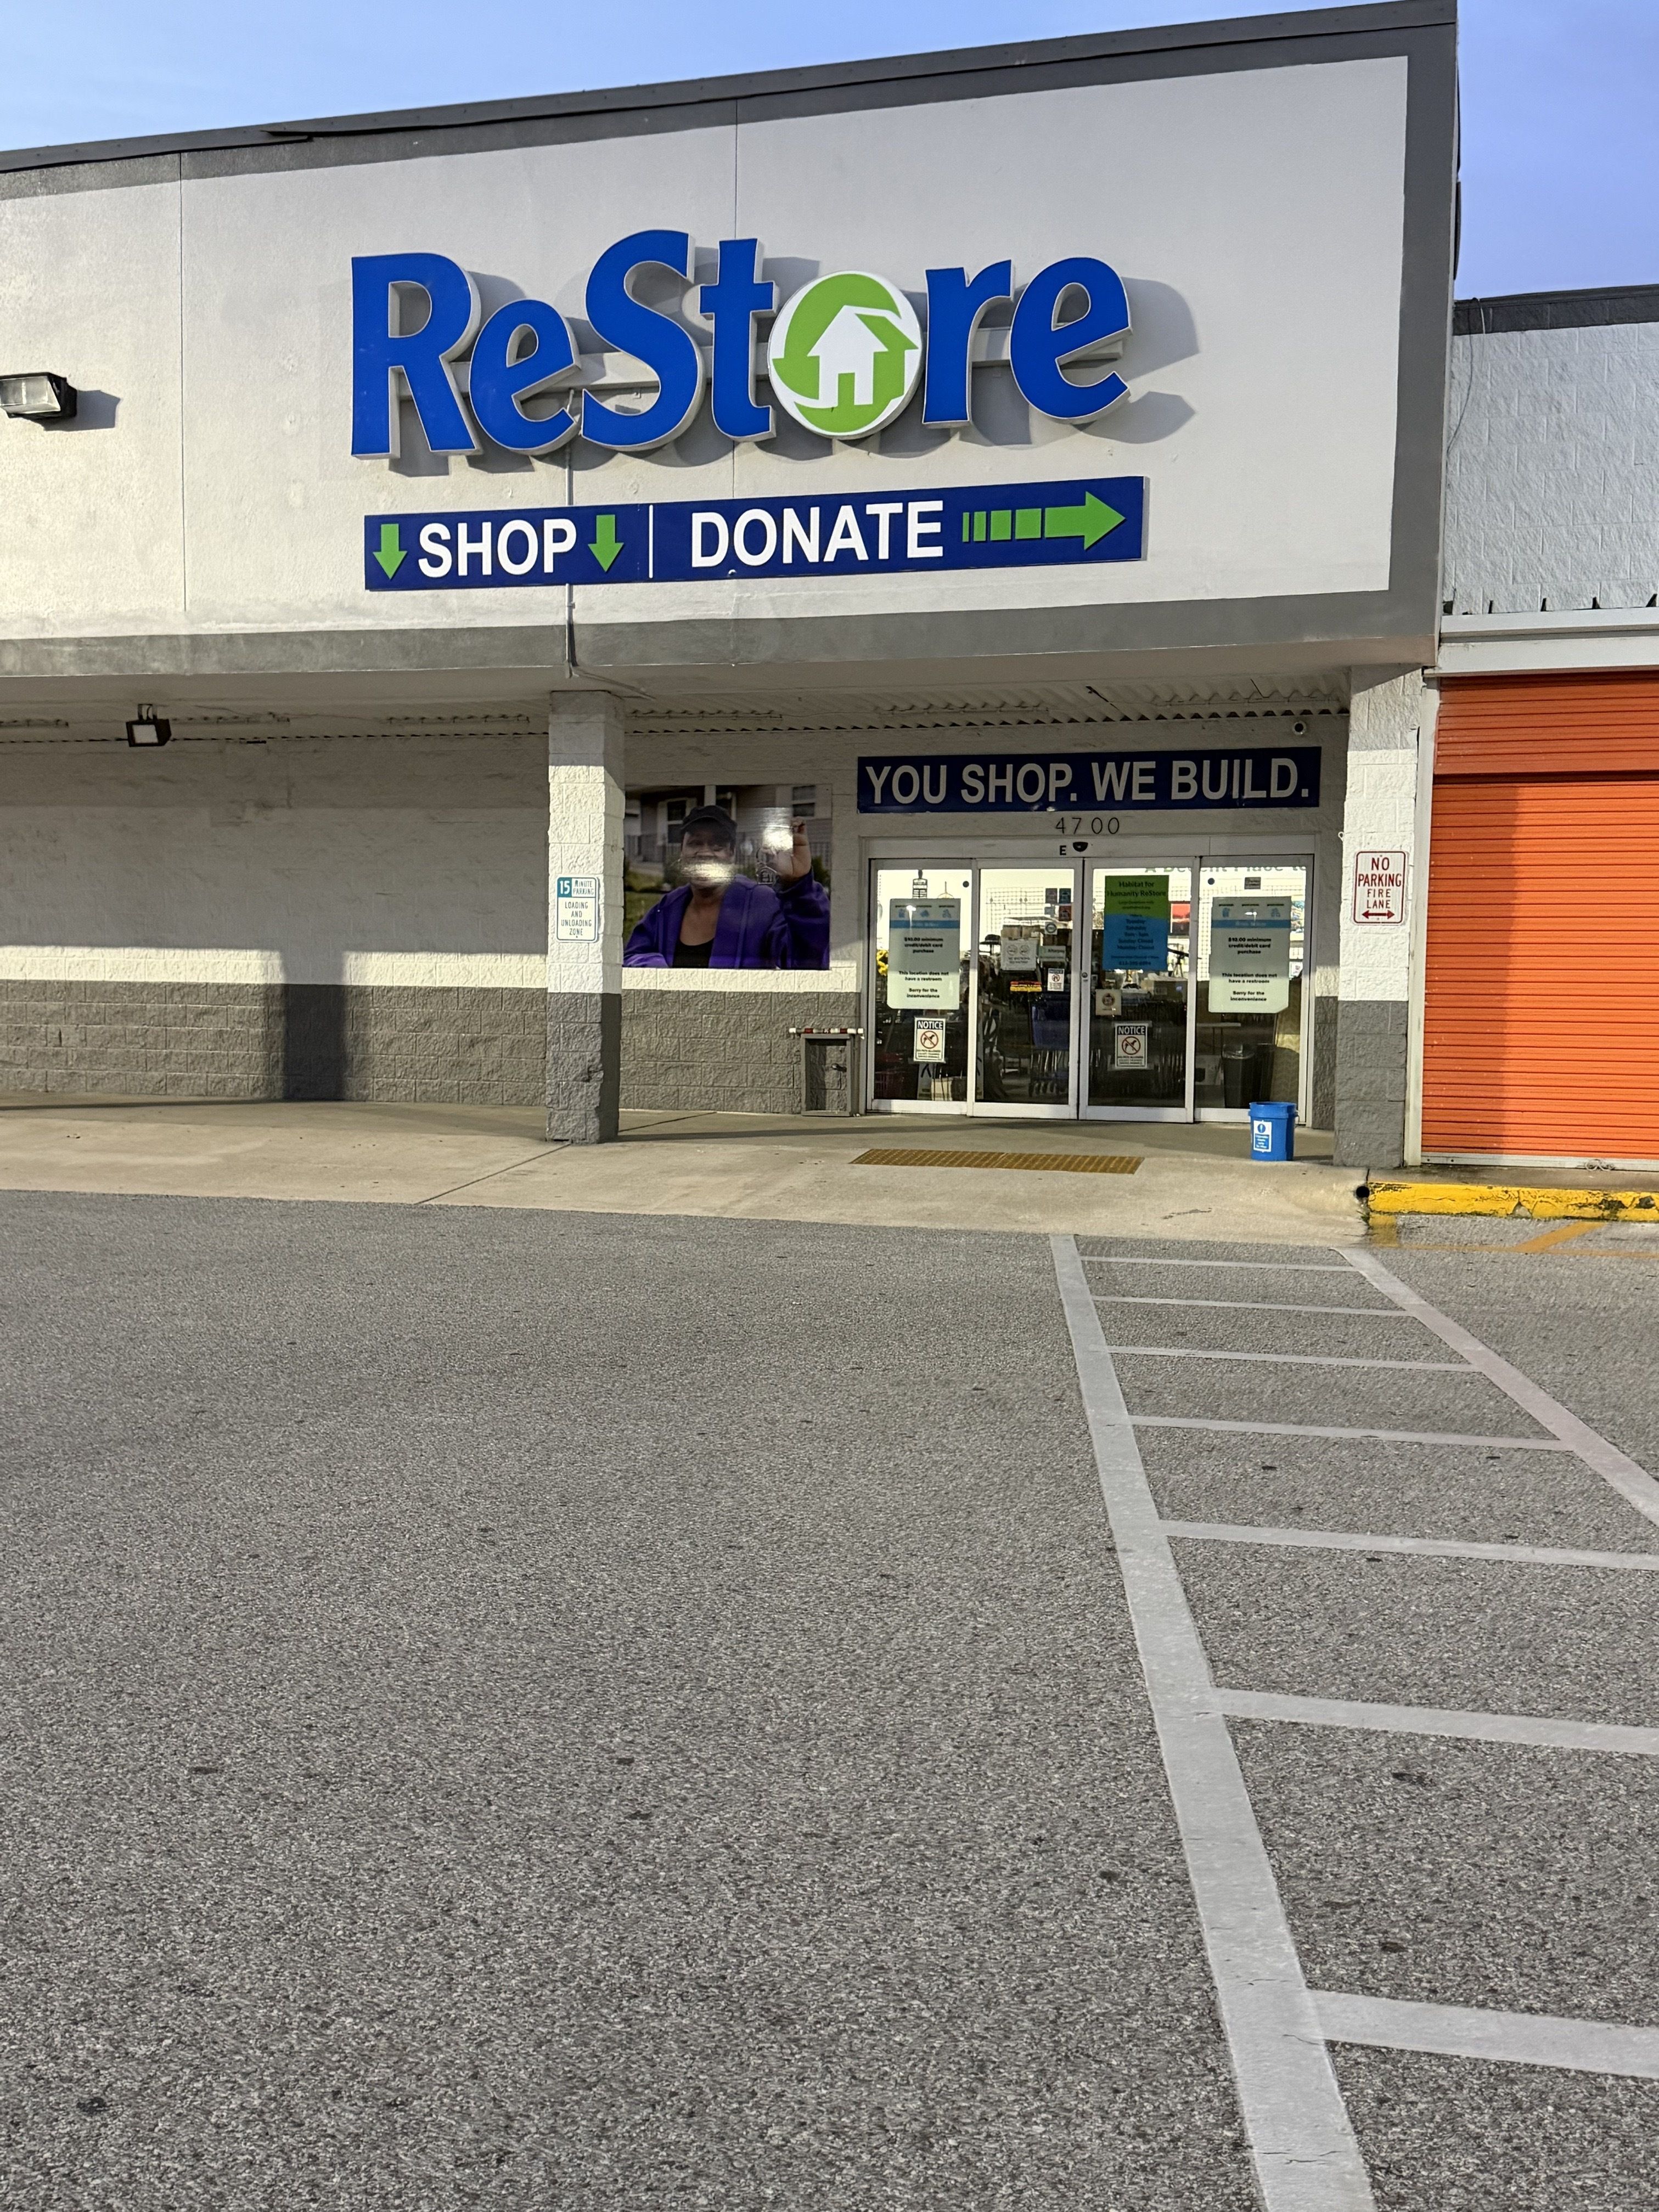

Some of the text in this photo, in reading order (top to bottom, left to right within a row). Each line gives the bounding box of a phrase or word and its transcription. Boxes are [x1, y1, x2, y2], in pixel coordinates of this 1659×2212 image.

[418, 500, 943, 578] SHOP DONATE
[865, 758, 1309, 804] YOU SHOP. WE BUILD.
[1055, 817, 1120, 834] 4700
[1371, 857, 1390, 871] NO
[560, 880, 570, 894] 15
[1358, 873, 1402, 887] PARKING
[1367, 888, 1391, 898] FIRE
[1366, 899, 1391, 909] LANE
[918, 1021, 943, 1029] NOTICE
[1118, 1026, 1145, 1035] NOTICE
